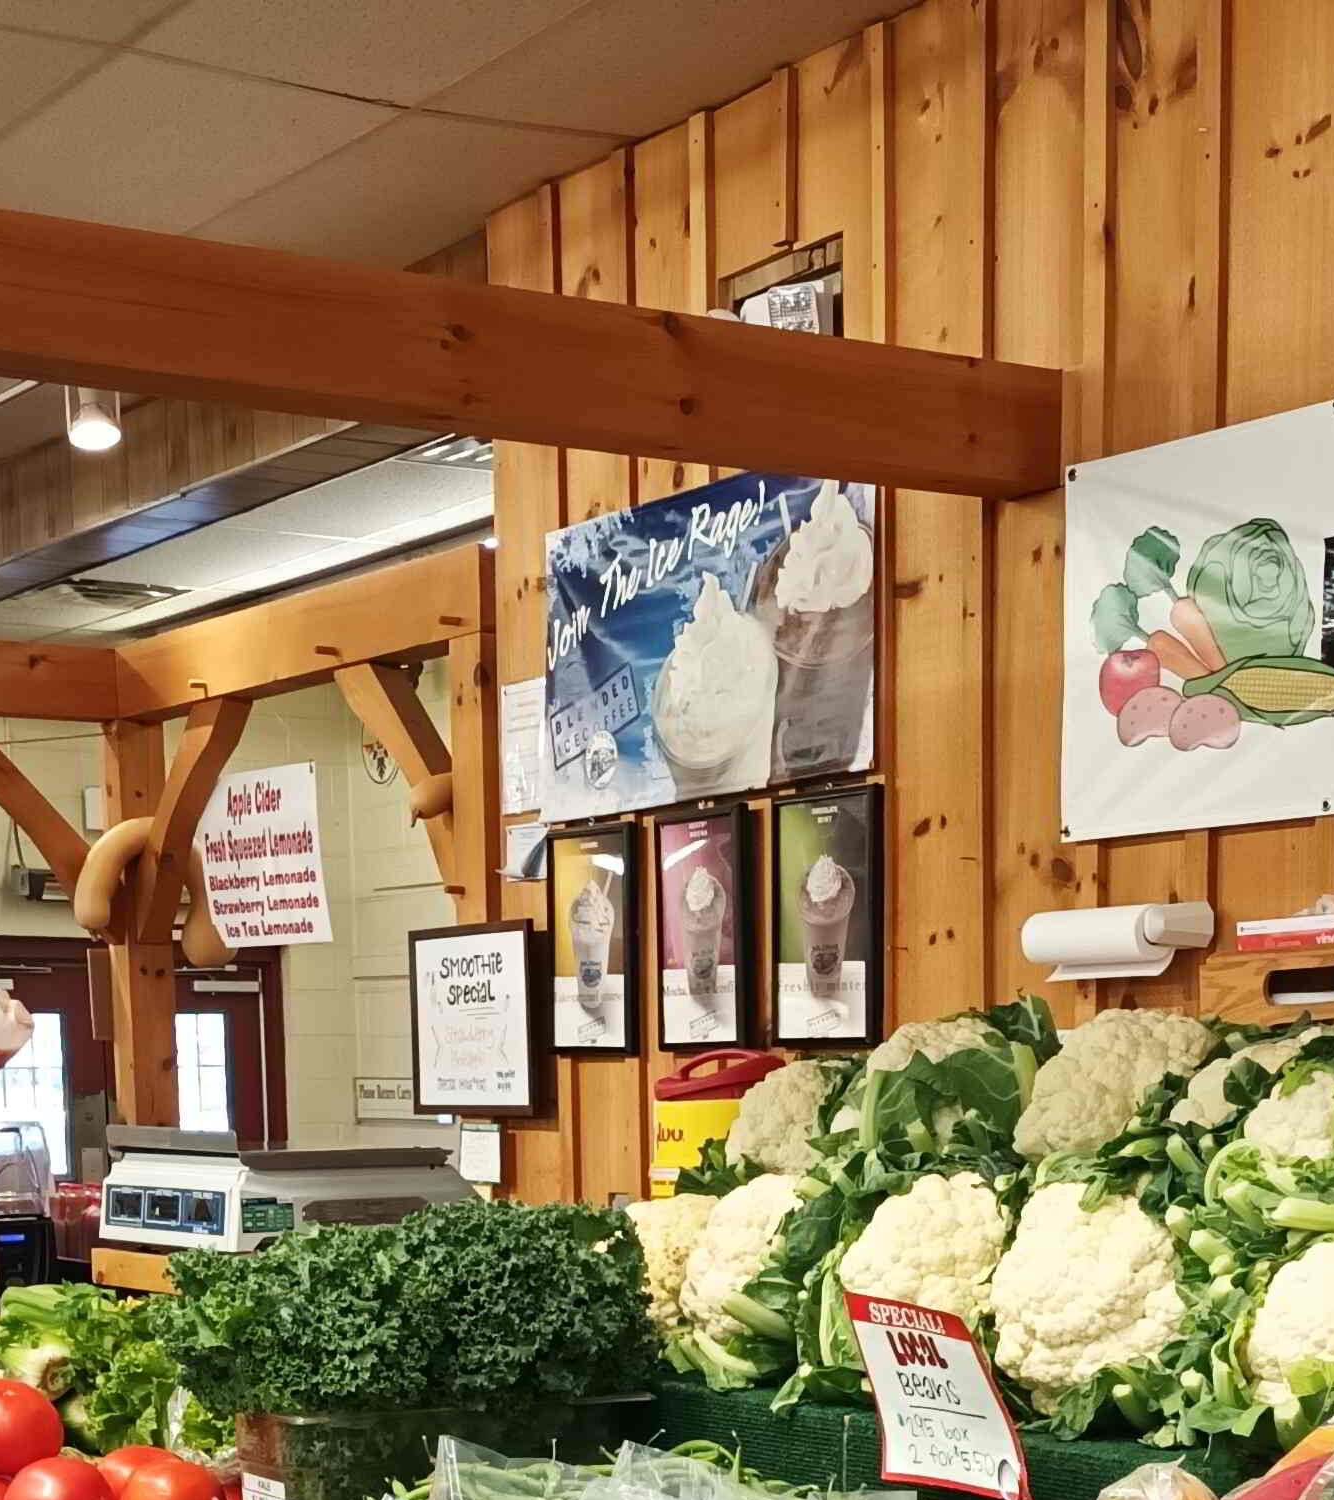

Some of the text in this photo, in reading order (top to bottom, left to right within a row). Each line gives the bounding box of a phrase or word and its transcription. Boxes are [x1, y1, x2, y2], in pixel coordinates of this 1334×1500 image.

[548, 480, 766, 671] Join The Ice Rage!
[227, 780, 282, 825] Apple Cider
[205, 822, 314, 869] Fresh Squeezed Lemonade
[208, 866, 317, 892] Blackberry Lemonade
[213, 892, 319, 917] Strawberry Lemonade
[226, 917, 314, 938] Ice Tea Lemonade
[868, 1302, 947, 1335] SPECIAL!
